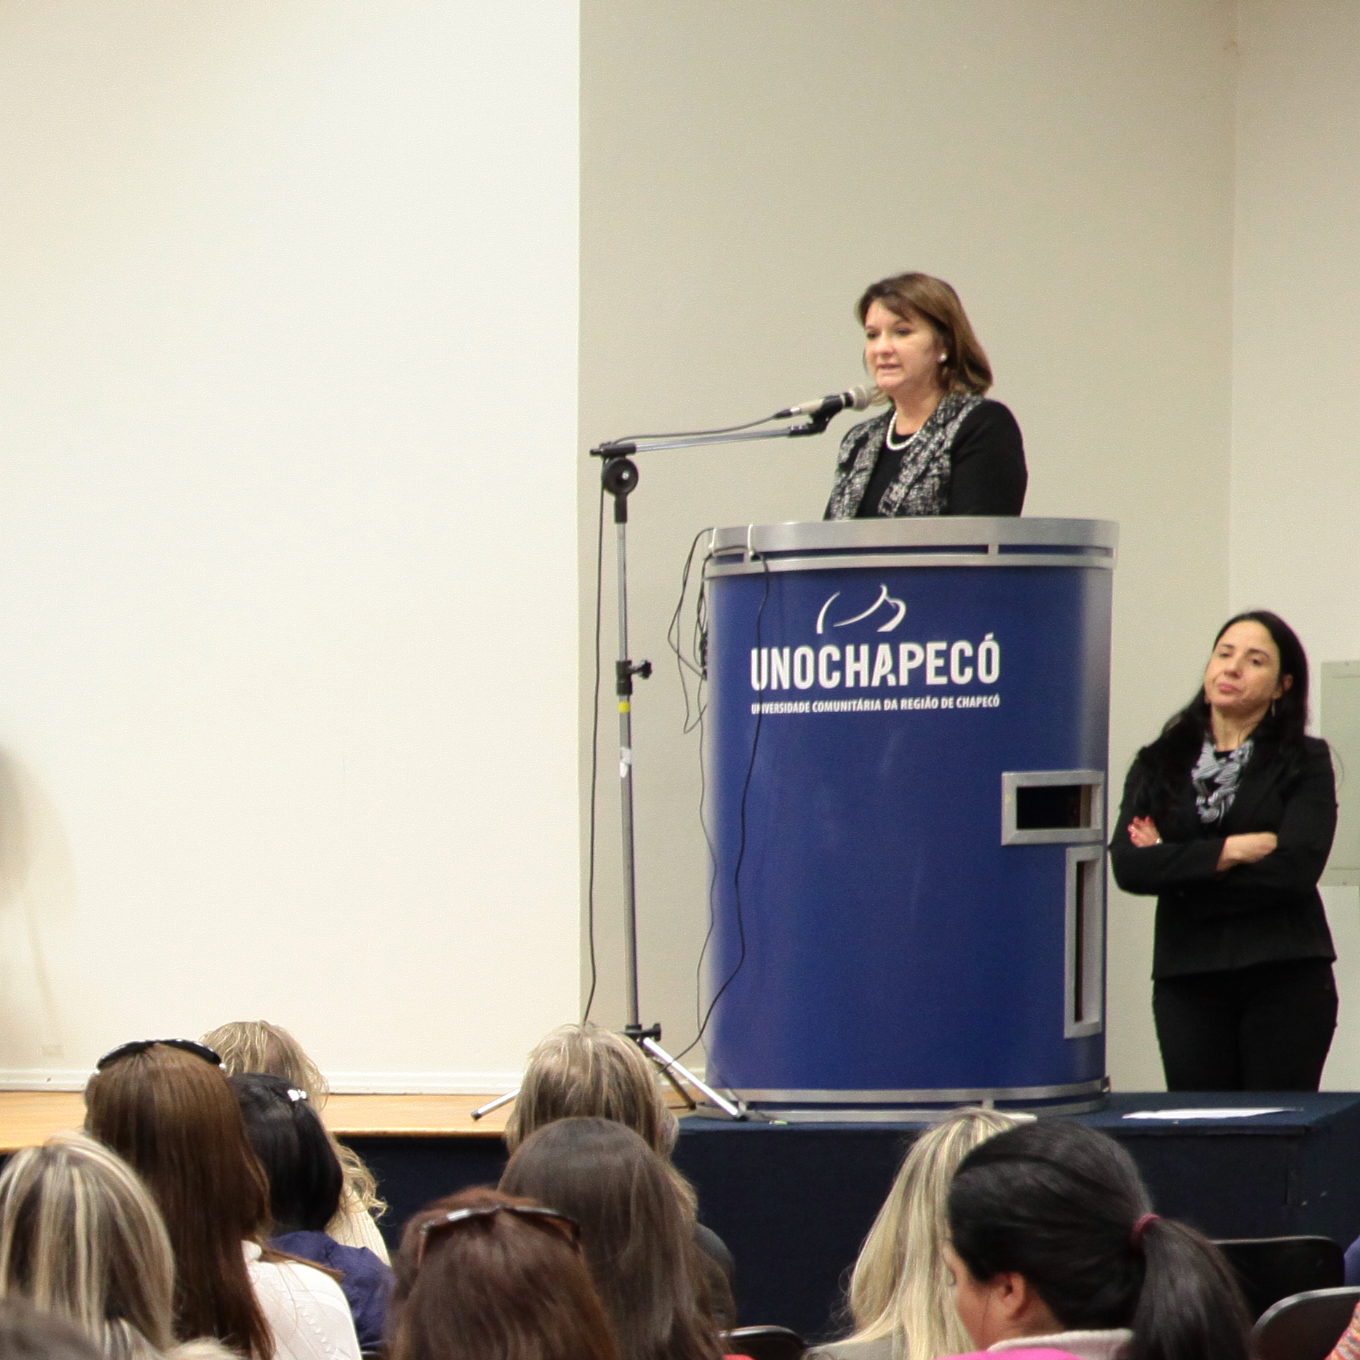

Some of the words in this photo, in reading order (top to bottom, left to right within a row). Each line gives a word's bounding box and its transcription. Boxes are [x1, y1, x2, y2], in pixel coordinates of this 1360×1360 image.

[750, 632, 1000, 692] UNOCHAPECÓ
[751, 701, 811, 715] UNIVERSIDADE
[812, 698, 881, 713] COMUNITÁRIA
[884, 699, 898, 711] DA
[900, 695, 939, 710] REGIÃO
[941, 697, 954, 709] DE
[956, 692, 1000, 708] CHAPECÓ
